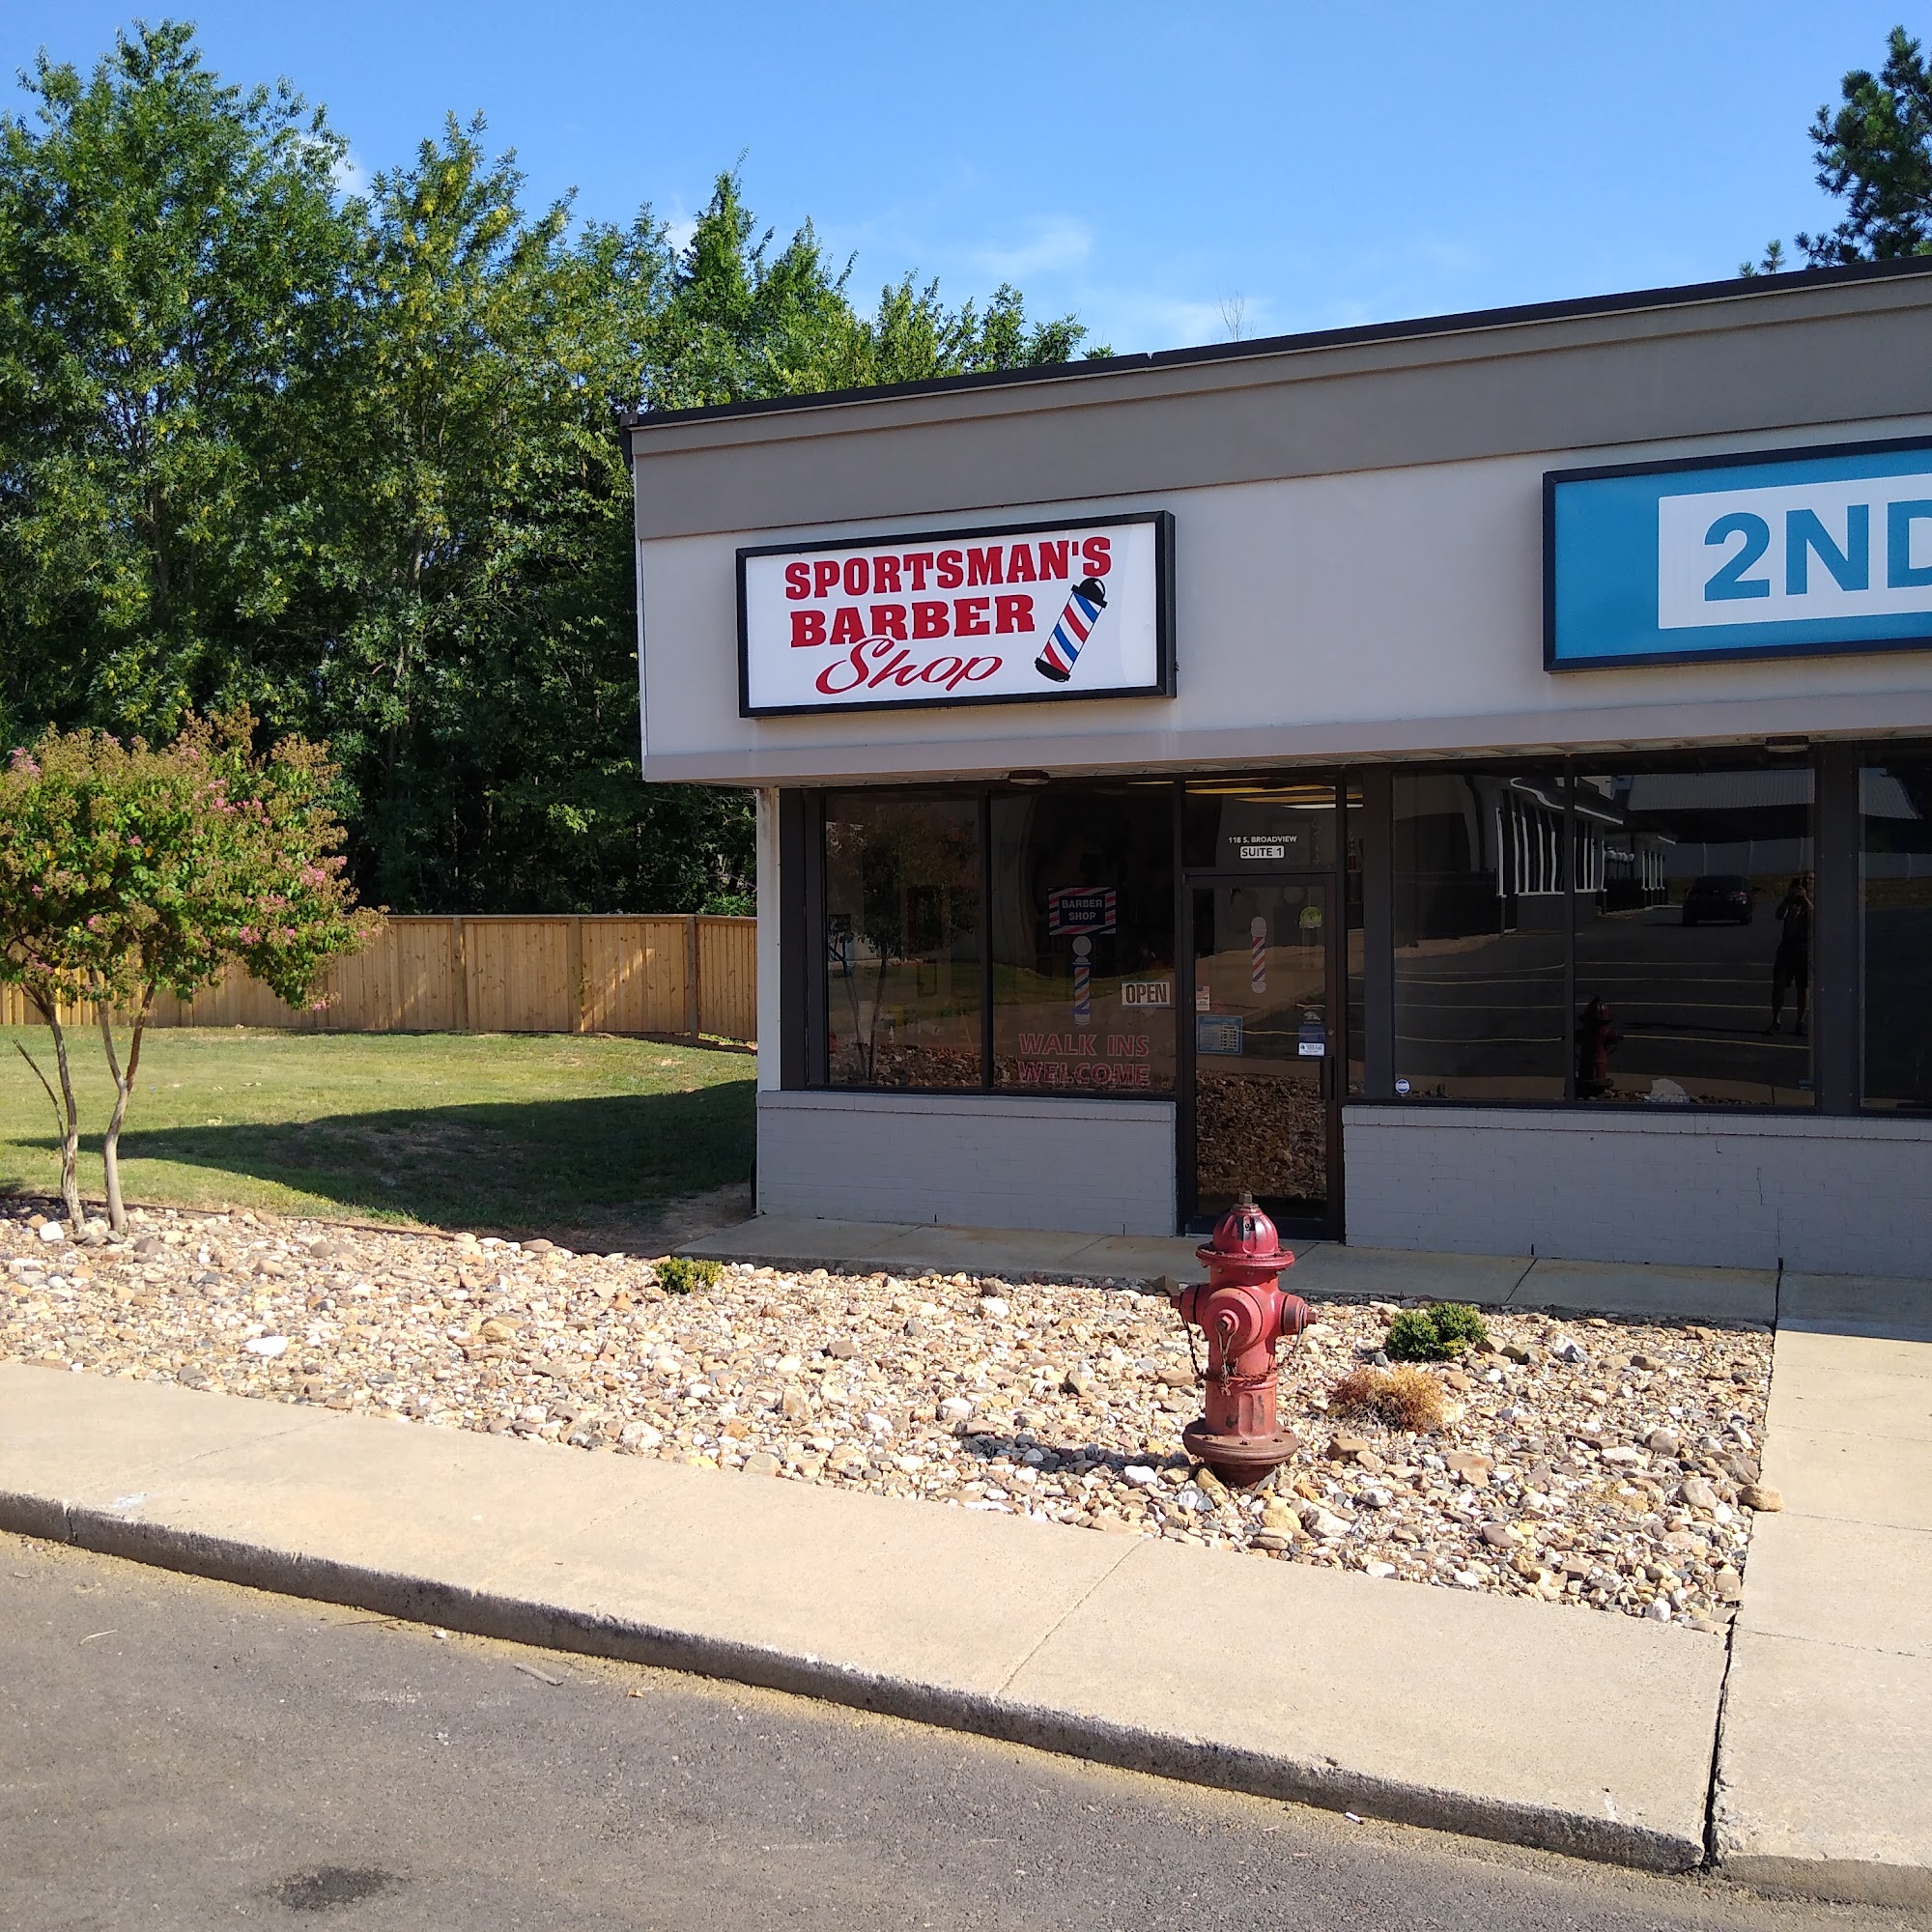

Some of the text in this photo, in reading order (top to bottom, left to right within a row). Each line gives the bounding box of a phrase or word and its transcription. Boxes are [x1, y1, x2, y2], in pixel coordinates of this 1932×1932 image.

[1704, 499, 1932, 601] 2ND
[785, 536, 1112, 600] SPORTSMAN'S
[790, 594, 1036, 648] BARBER
[816, 638, 1003, 695] Shop
[1251, 835, 1297, 843] BROADVIEW
[1241, 847, 1282, 857] SUITE 1
[1062, 898, 1103, 909] BARBER
[1068, 911, 1097, 922] SHOP
[1125, 982, 1168, 1004] OPEN
[1018, 1033, 1150, 1057] WALK INS
[1017, 1061, 1151, 1086] WELCOME
